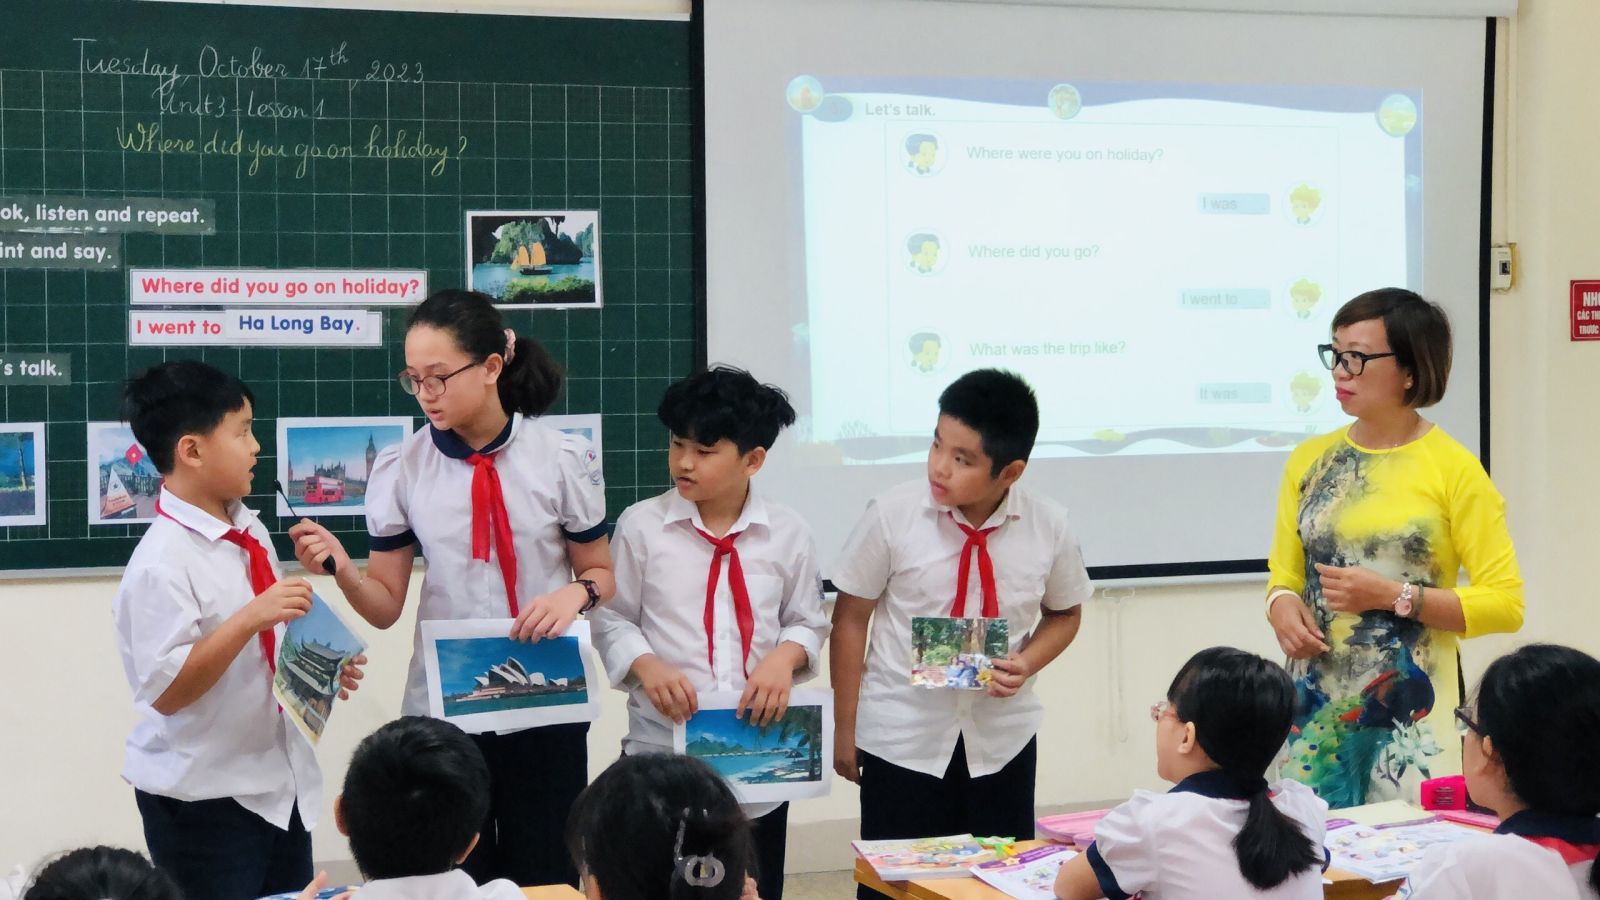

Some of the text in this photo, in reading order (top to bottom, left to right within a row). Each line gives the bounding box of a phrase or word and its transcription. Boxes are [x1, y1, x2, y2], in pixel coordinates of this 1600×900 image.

[199, 45, 288, 79] October
[366, 60, 424, 84] 2023
[865, 103, 901, 116] Let's
[906, 103, 936, 116] talk.
[116, 122, 194, 152] Where
[204, 129, 243, 155] did
[248, 139, 288, 176] you
[295, 143, 321, 178] go
[327, 143, 356, 160] on
[966, 146, 1163, 163] Where were you on holiday?
[1202, 195, 1238, 210] I was
[36, 204, 89, 222] listen
[95, 206, 131, 222] and
[137, 208, 205, 226] repeat.
[30, 242, 67, 259] and
[74, 246, 112, 263] say.
[968, 244, 1100, 261] Where did you go?
[142, 278, 419, 298] Where did you go on holiday?
[1181, 292, 1239, 305] I went to
[136, 315, 360, 334] I went to Ha Long Bay.
[969, 340, 1126, 357] What was the trip like?
[20, 360, 63, 376] talk.
[1199, 387, 1239, 401] It was
